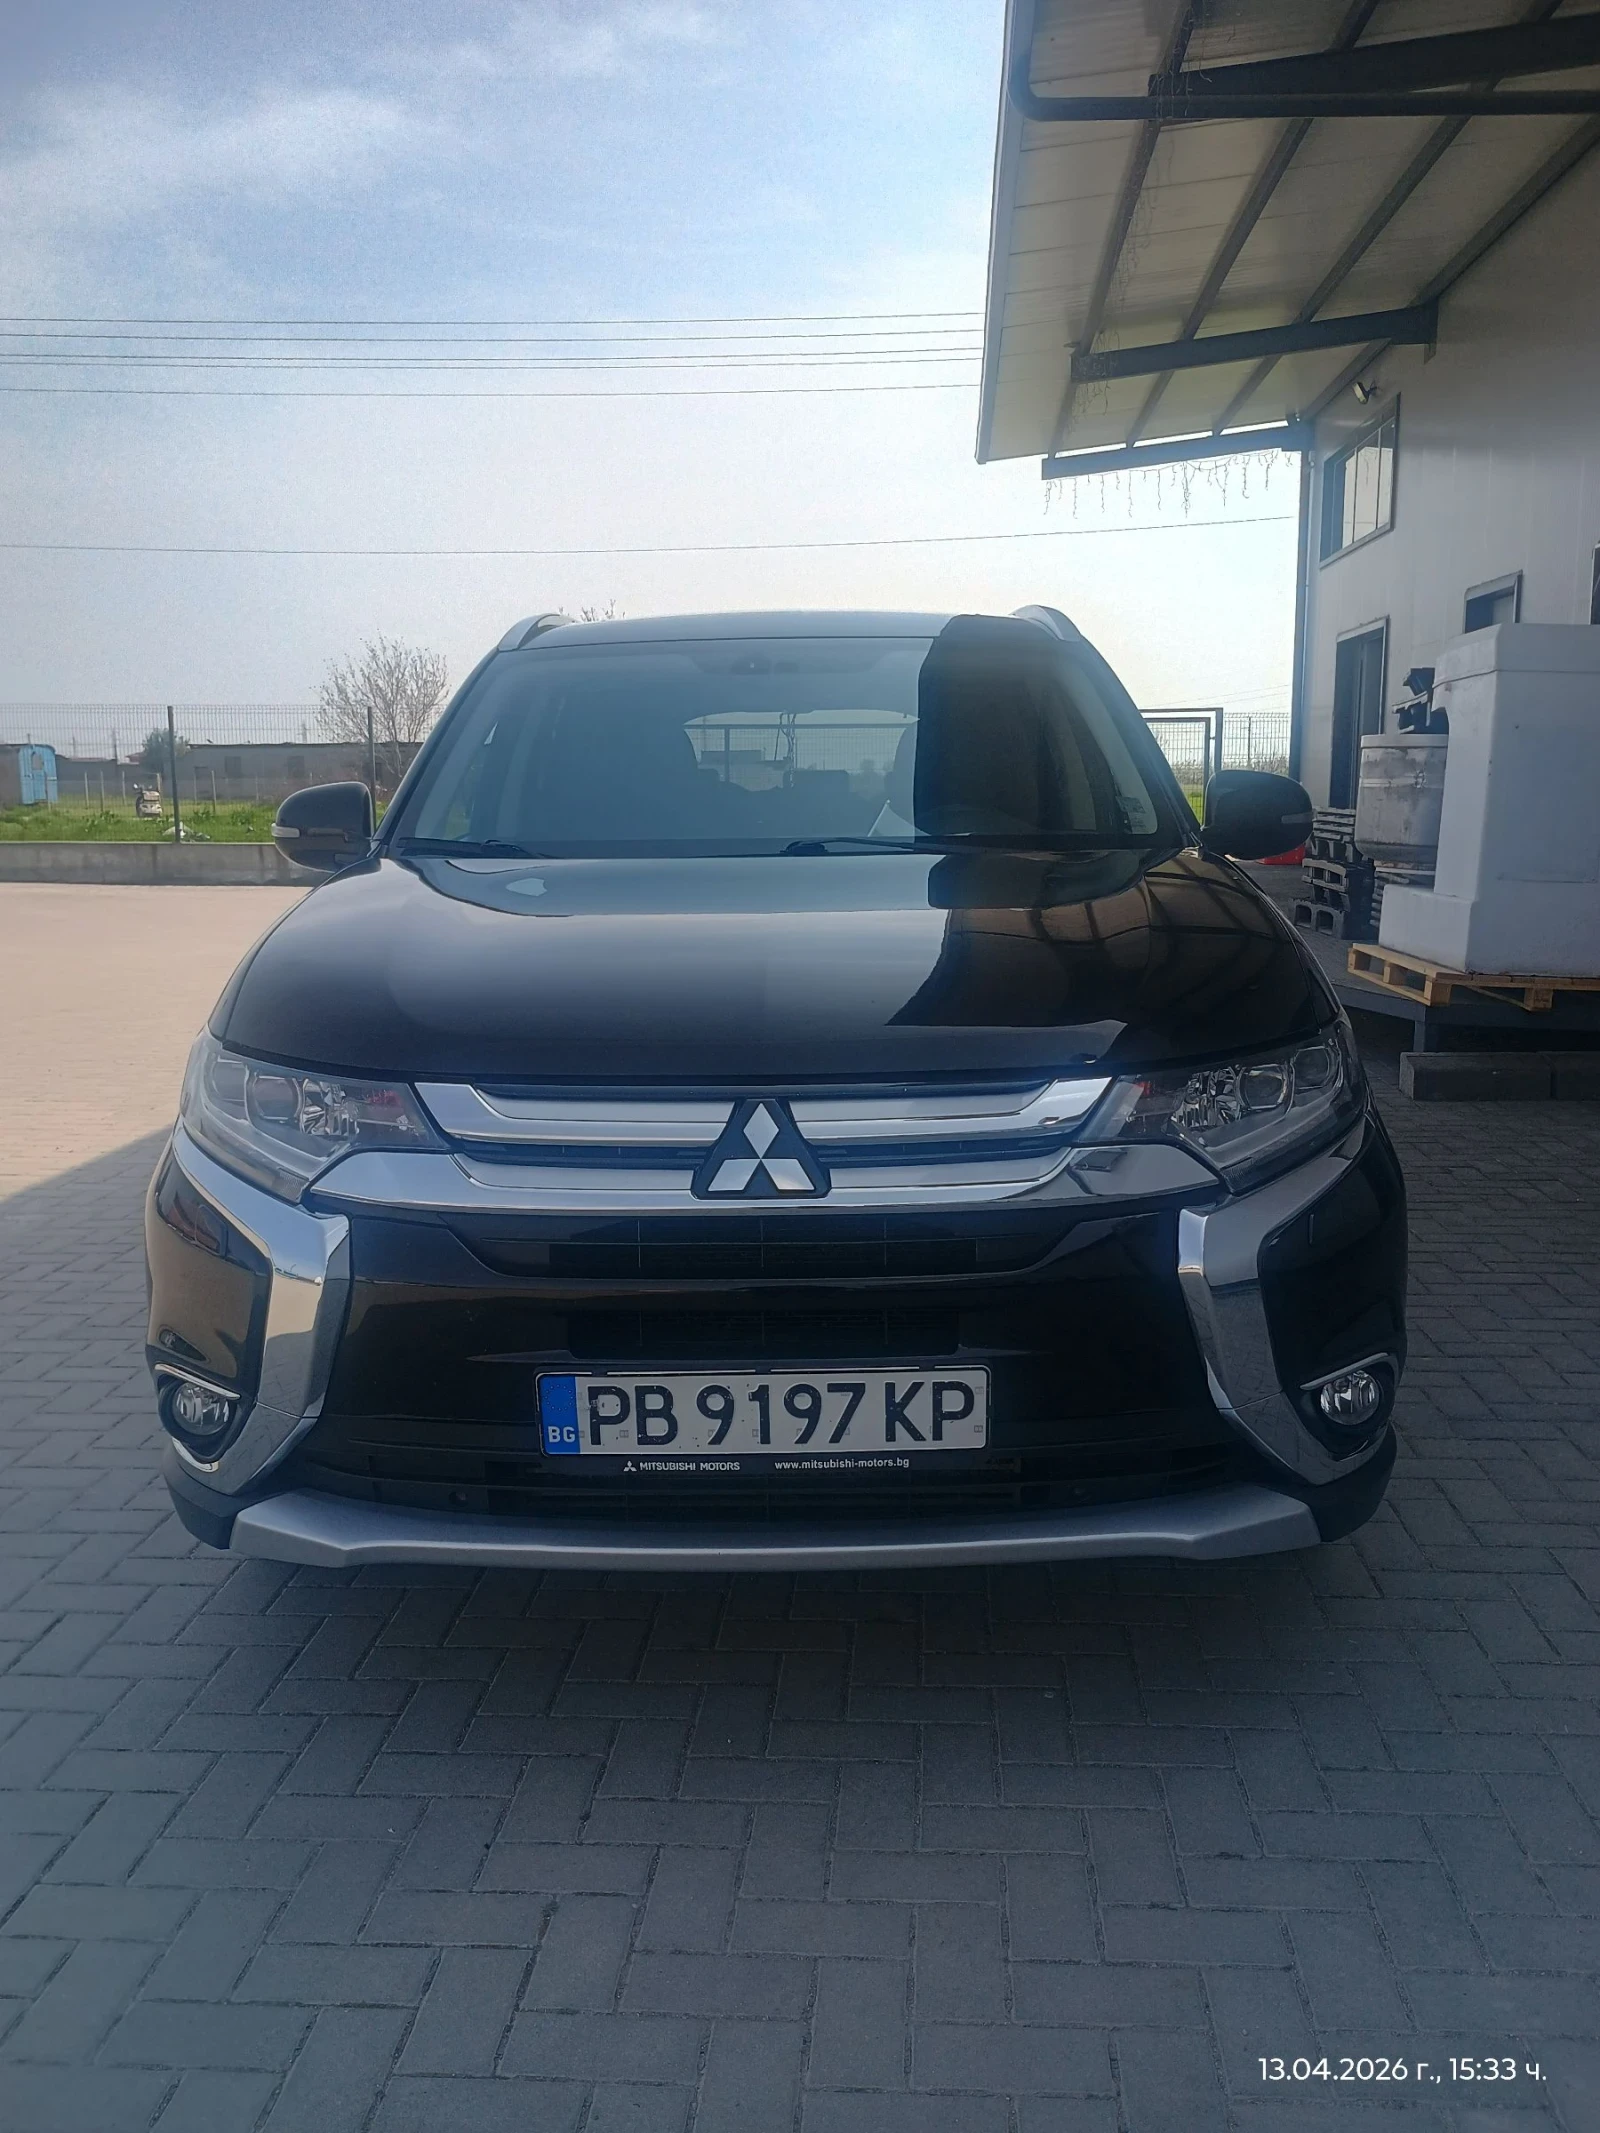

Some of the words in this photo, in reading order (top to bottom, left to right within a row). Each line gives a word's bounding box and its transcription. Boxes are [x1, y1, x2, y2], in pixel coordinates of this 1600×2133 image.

[587, 1385, 679, 1446] PB
[696, 1382, 867, 1446] 9197
[884, 1380, 976, 1443] KP
[547, 1426, 576, 1443] BG
[639, 1461, 696, 1472] MITSUBISHI
[699, 1461, 741, 1472] MOTORS
[774, 1457, 910, 1470] www.mitsubishi-motors.bg
